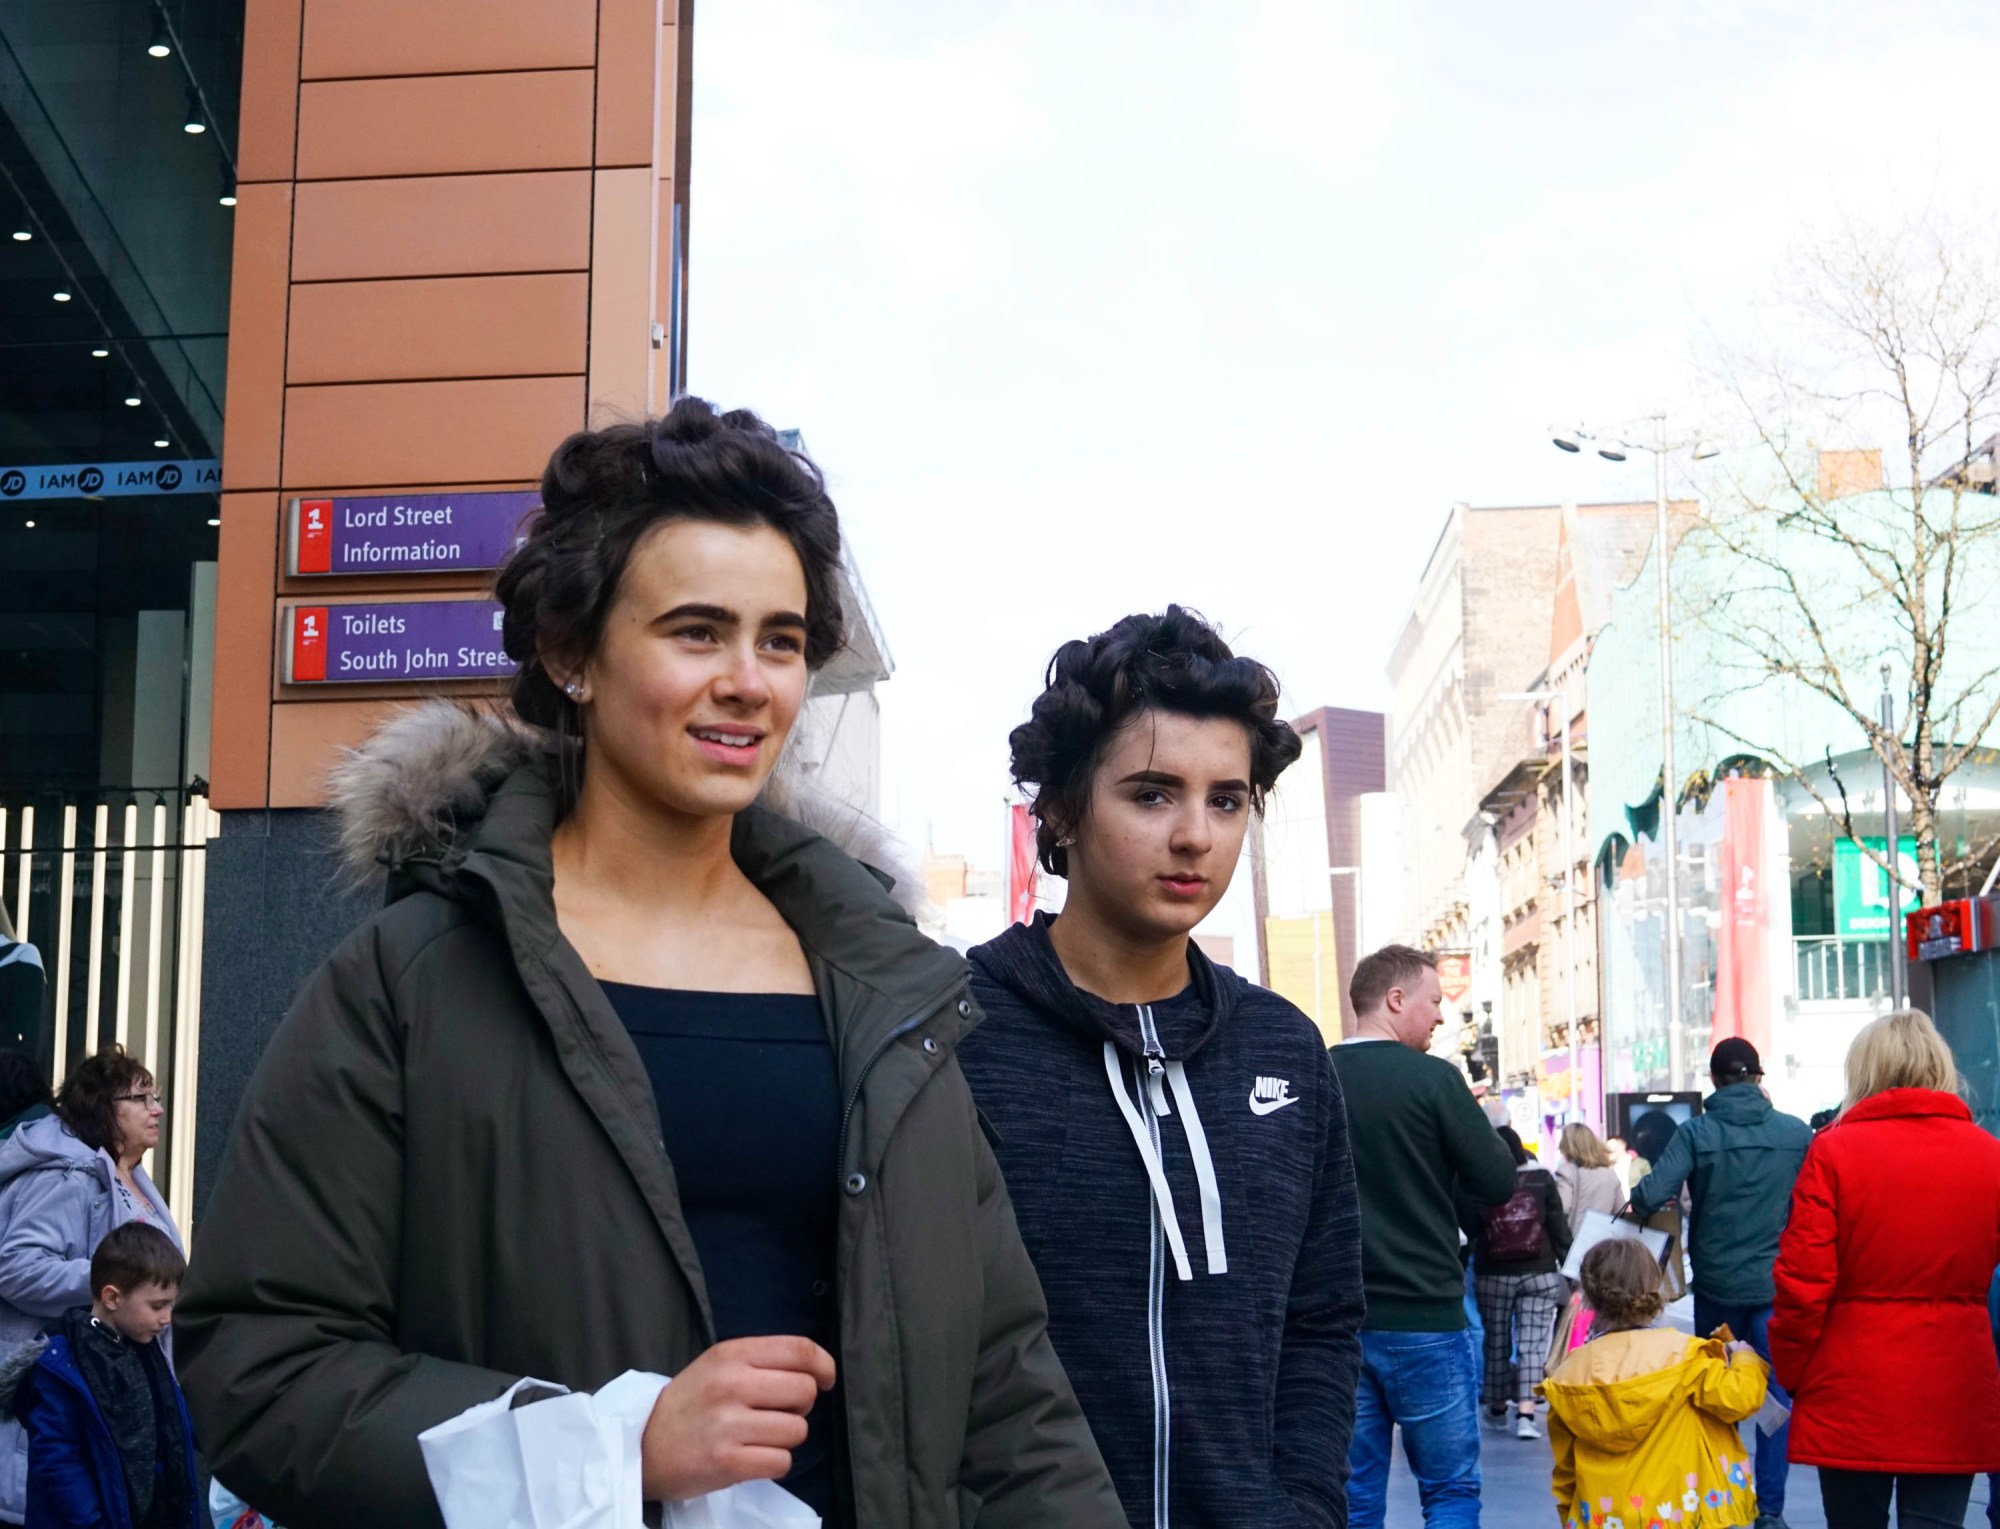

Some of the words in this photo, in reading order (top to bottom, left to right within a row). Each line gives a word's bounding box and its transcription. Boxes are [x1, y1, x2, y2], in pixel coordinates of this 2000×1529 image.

[47, 474, 75, 488] AM
[125, 471, 153, 485] AM
[345, 507, 387, 527] Lord
[393, 506, 452, 526] Street
[344, 540, 460, 562] Information
[342, 614, 406, 635] Toilets
[340, 649, 397, 670] South
[404, 648, 448, 674] John
[457, 648, 516, 667] Stree
[1255, 1076, 1289, 1100] NIKE
